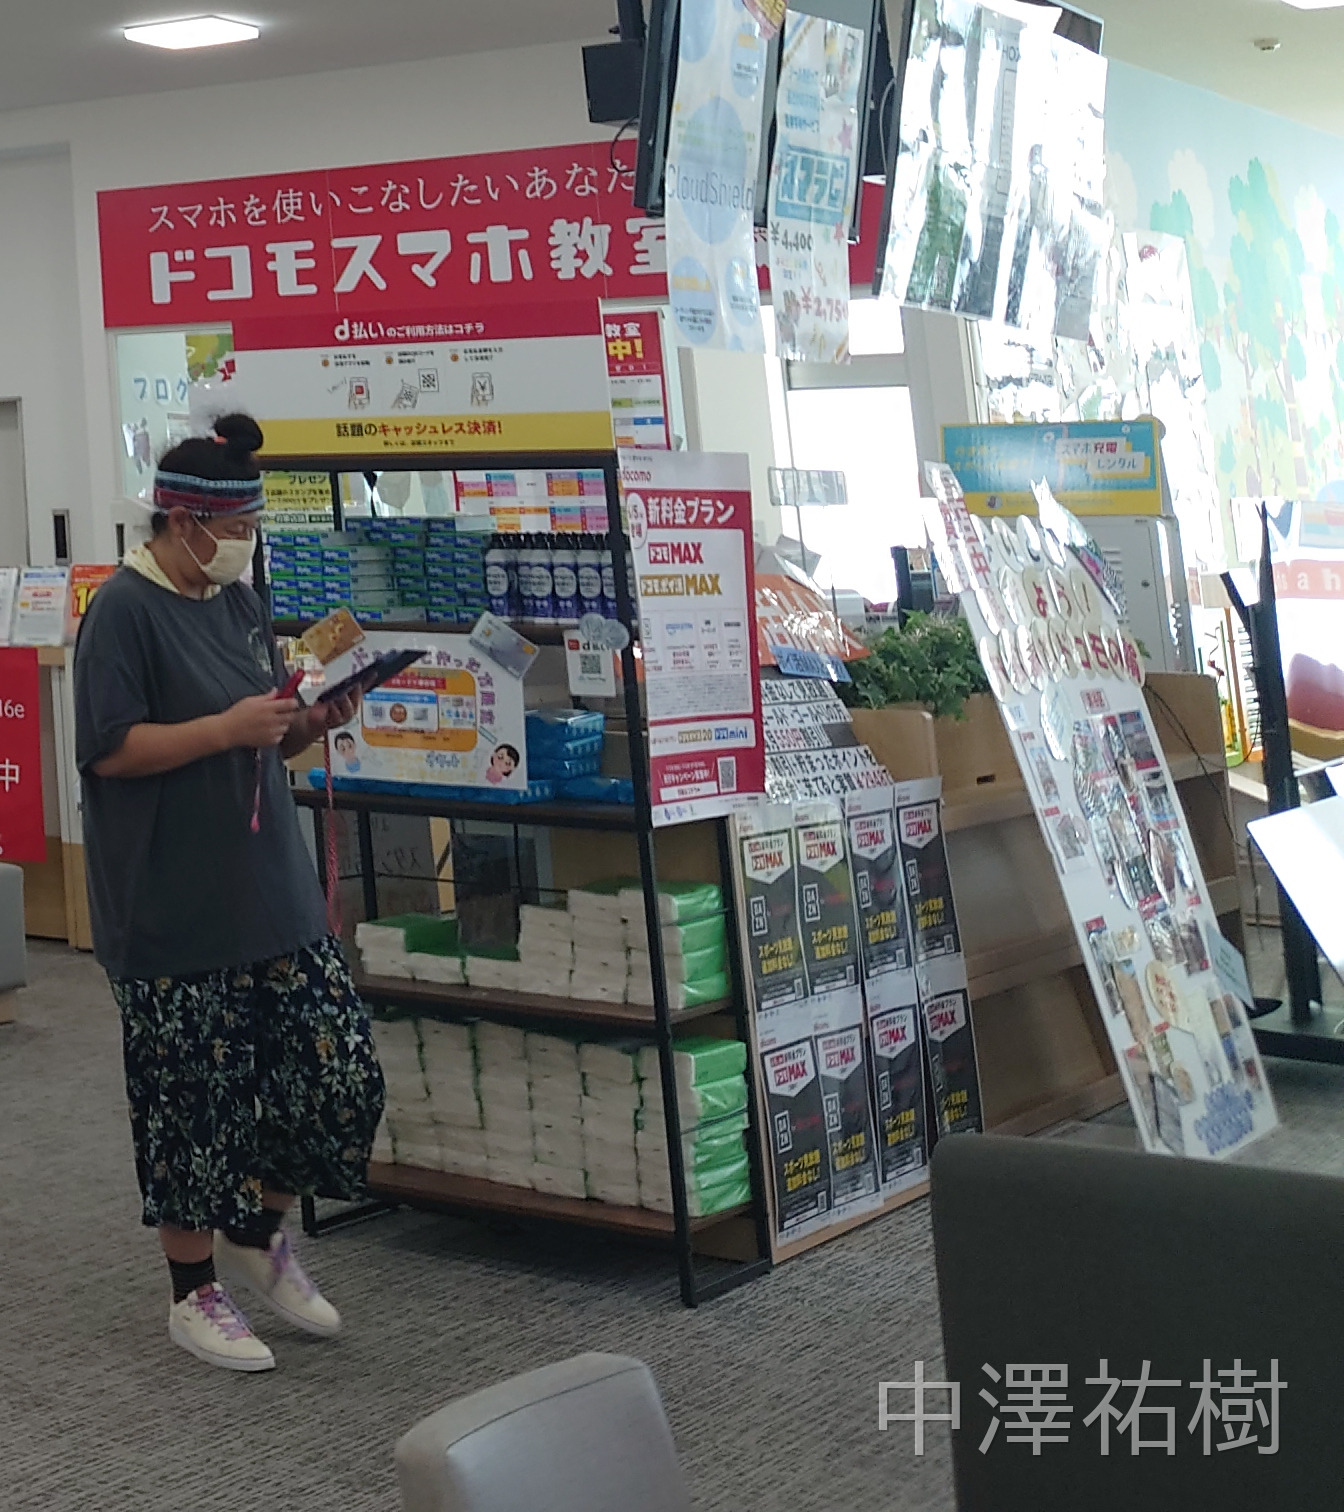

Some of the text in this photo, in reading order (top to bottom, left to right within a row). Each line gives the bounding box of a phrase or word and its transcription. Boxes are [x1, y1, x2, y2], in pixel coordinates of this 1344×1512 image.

[667, 164, 755, 211] CloudShield
[648, 497, 735, 525] 新料金プラン
